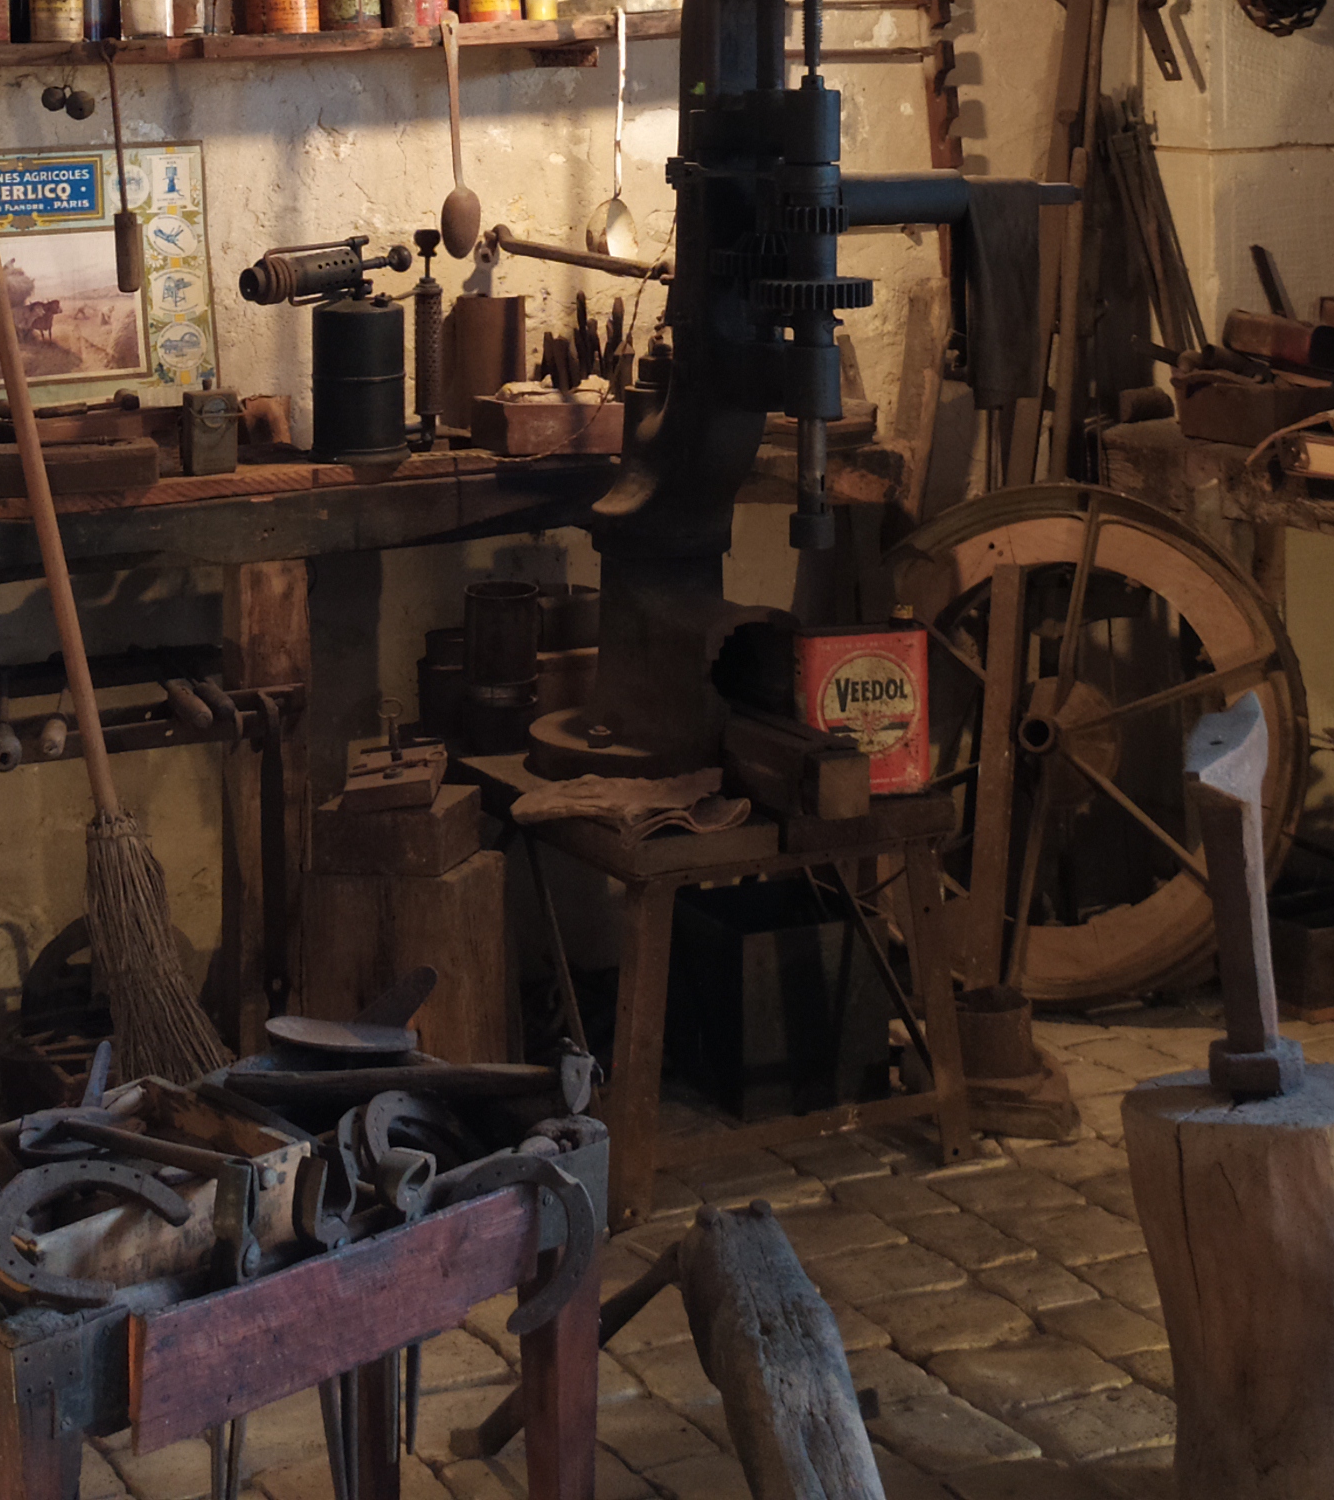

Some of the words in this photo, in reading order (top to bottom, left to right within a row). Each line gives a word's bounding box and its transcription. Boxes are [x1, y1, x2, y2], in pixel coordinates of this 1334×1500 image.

[23, 169, 89, 182] AGRICOLES
[53, 199, 89, 209] PARIS
[834, 678, 908, 713] VEEDOL
